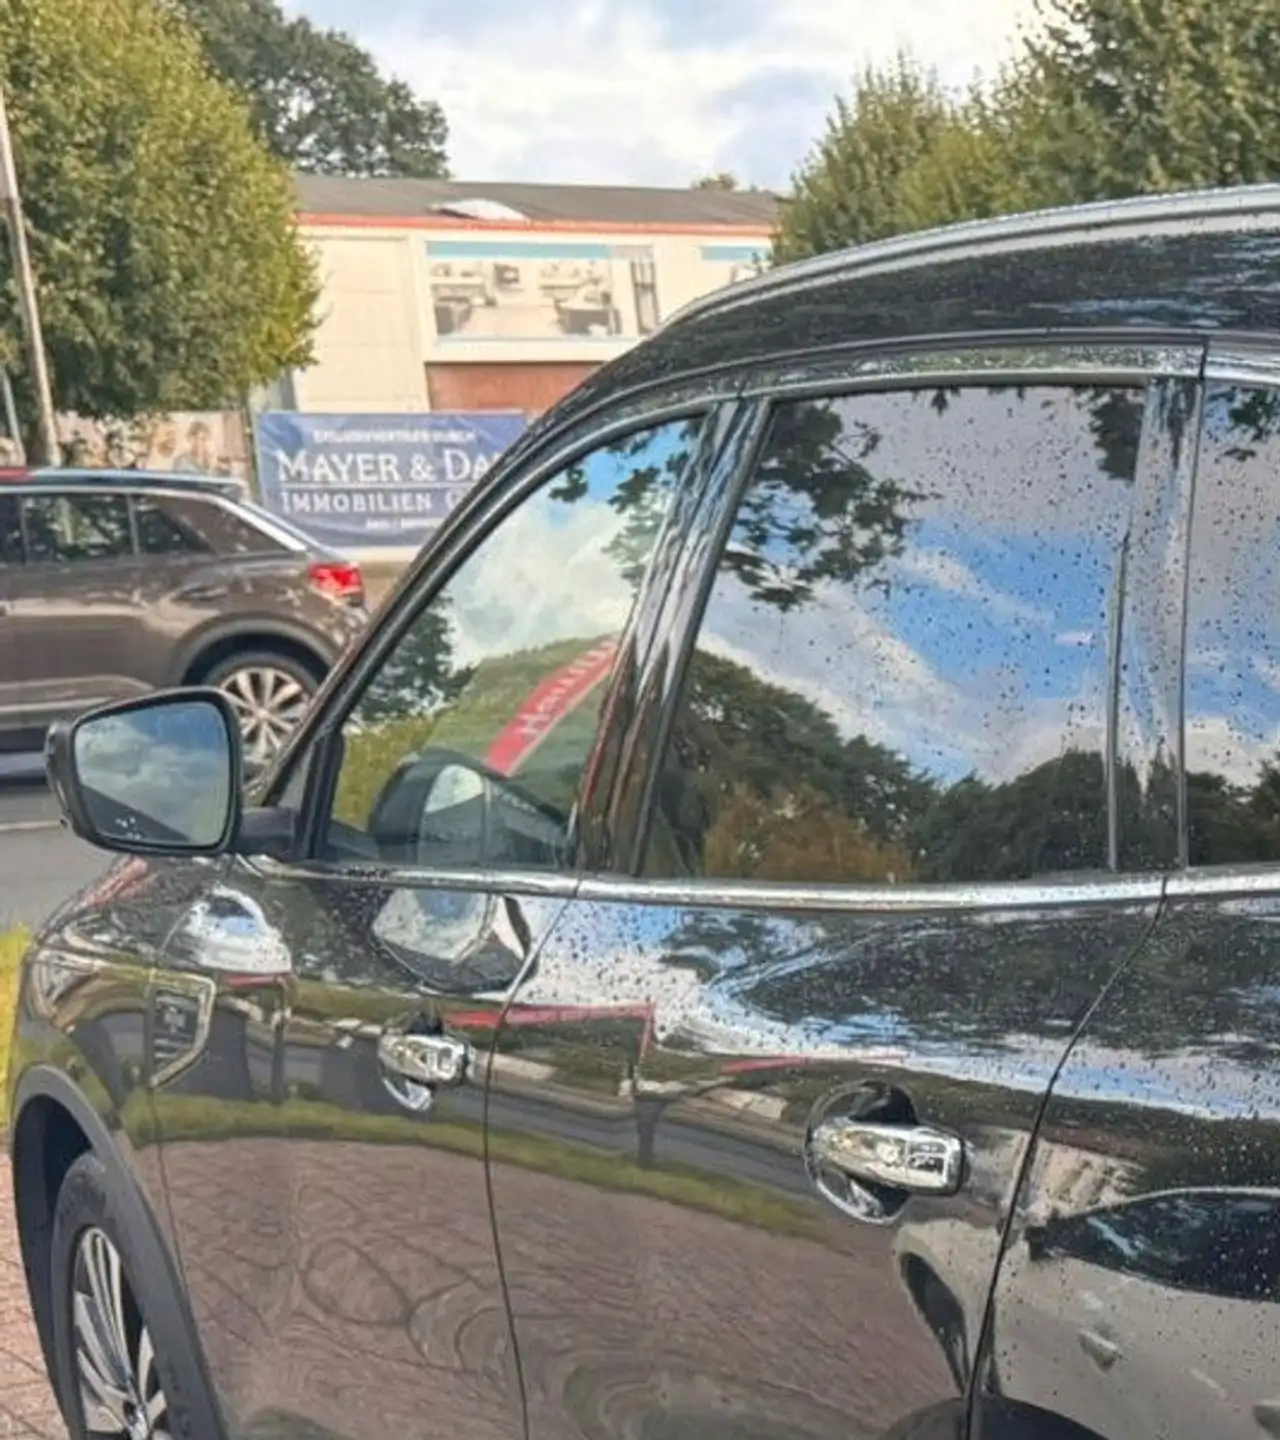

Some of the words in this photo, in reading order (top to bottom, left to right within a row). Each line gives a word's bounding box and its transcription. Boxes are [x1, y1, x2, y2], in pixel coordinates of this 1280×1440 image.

[278, 448, 398, 482] MAYER
[410, 455, 436, 482] &
[281, 491, 432, 514] IMMOBILIEN
